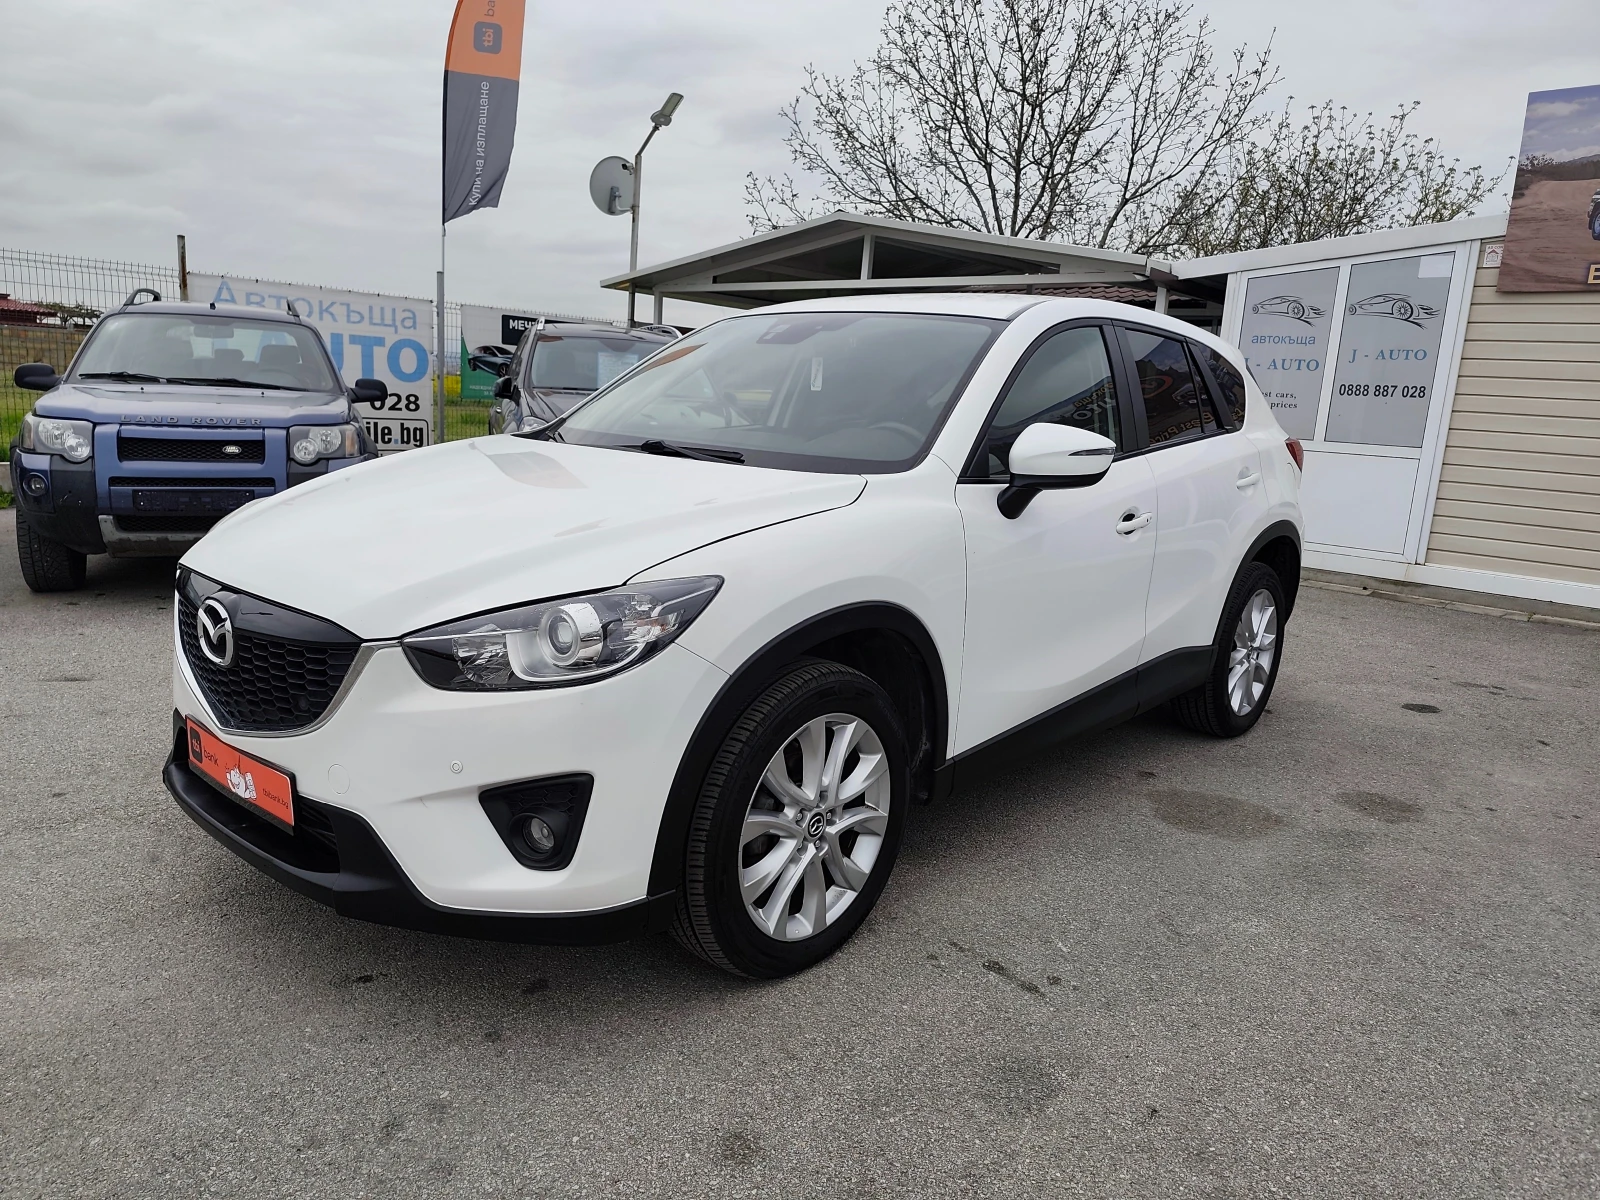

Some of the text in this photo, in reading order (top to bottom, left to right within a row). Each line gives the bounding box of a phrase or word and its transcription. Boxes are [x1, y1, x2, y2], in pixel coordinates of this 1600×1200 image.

[483, 28, 494, 47] tbi
[469, 81, 490, 206] Купи на изплащане
[212, 280, 418, 334] Автокъща
[1251, 333, 1316, 346] автокъща
[1349, 348, 1358, 364] J
[1375, 348, 1428, 361] AUTO
[1267, 358, 1320, 371] AUTO
[1275, 392, 1297, 400] cars,
[1338, 383, 1427, 399] 0888 887 028
[1270, 401, 1298, 410] prices
[120, 415, 262, 426] LAND ROVER
[192, 739, 201, 754] tbi
